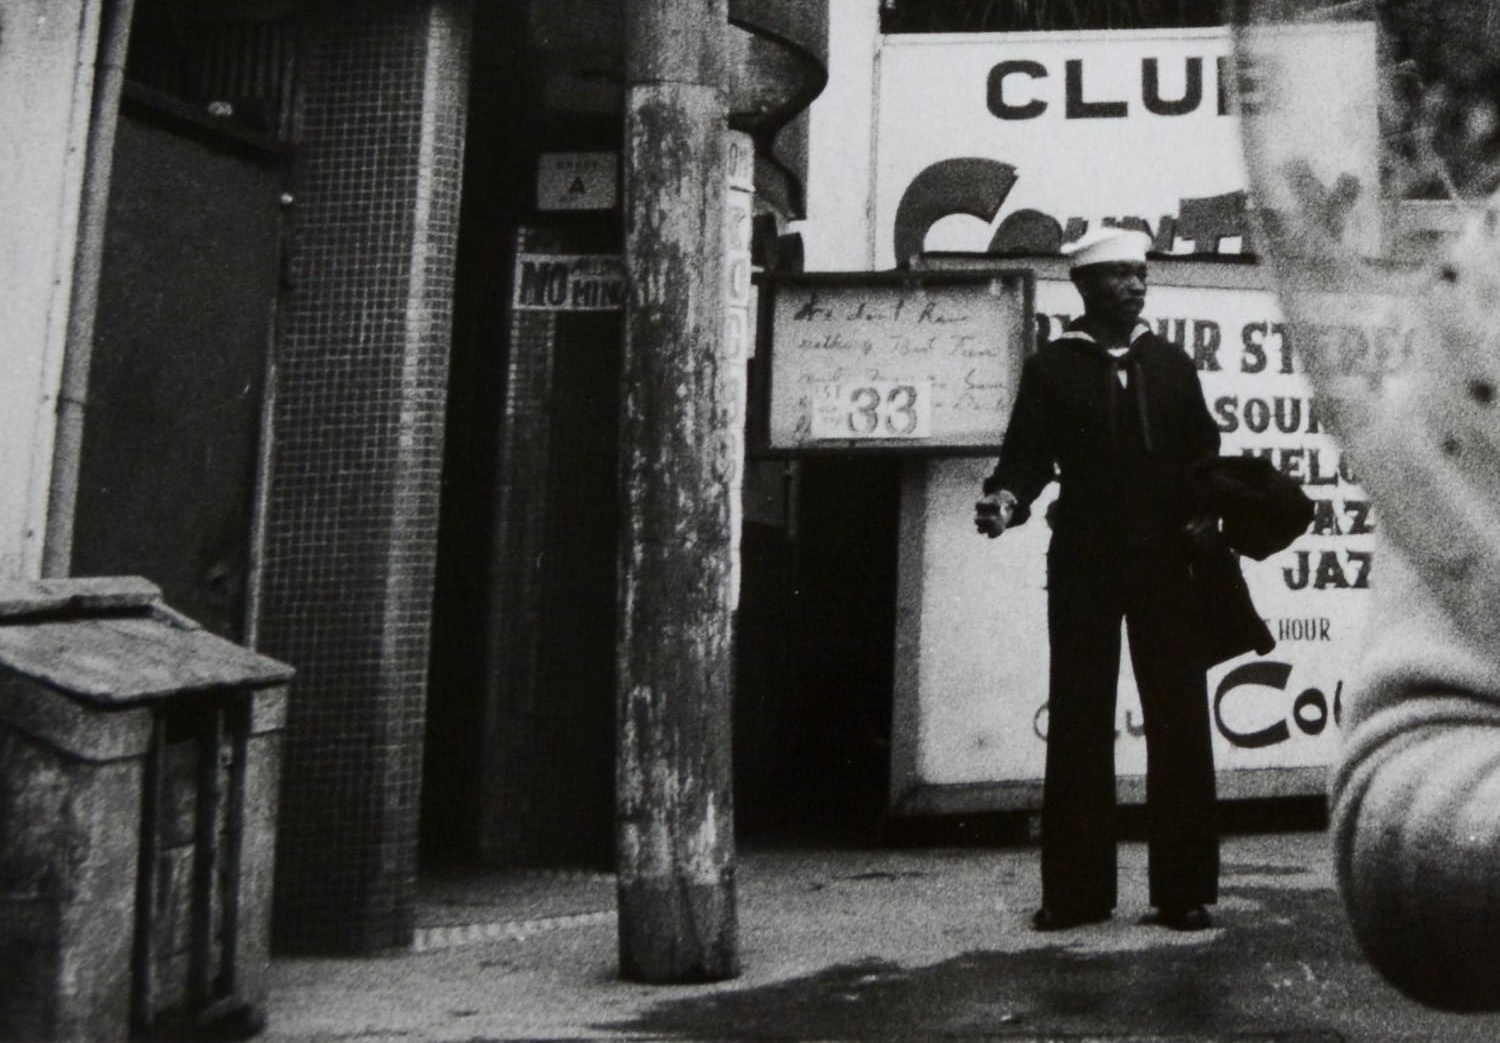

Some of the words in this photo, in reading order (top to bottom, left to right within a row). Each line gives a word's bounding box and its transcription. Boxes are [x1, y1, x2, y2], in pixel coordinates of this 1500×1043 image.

[848, 385, 918, 435] 33
[1279, 618, 1331, 642] HOUR
[1213, 660, 1345, 749] Co
